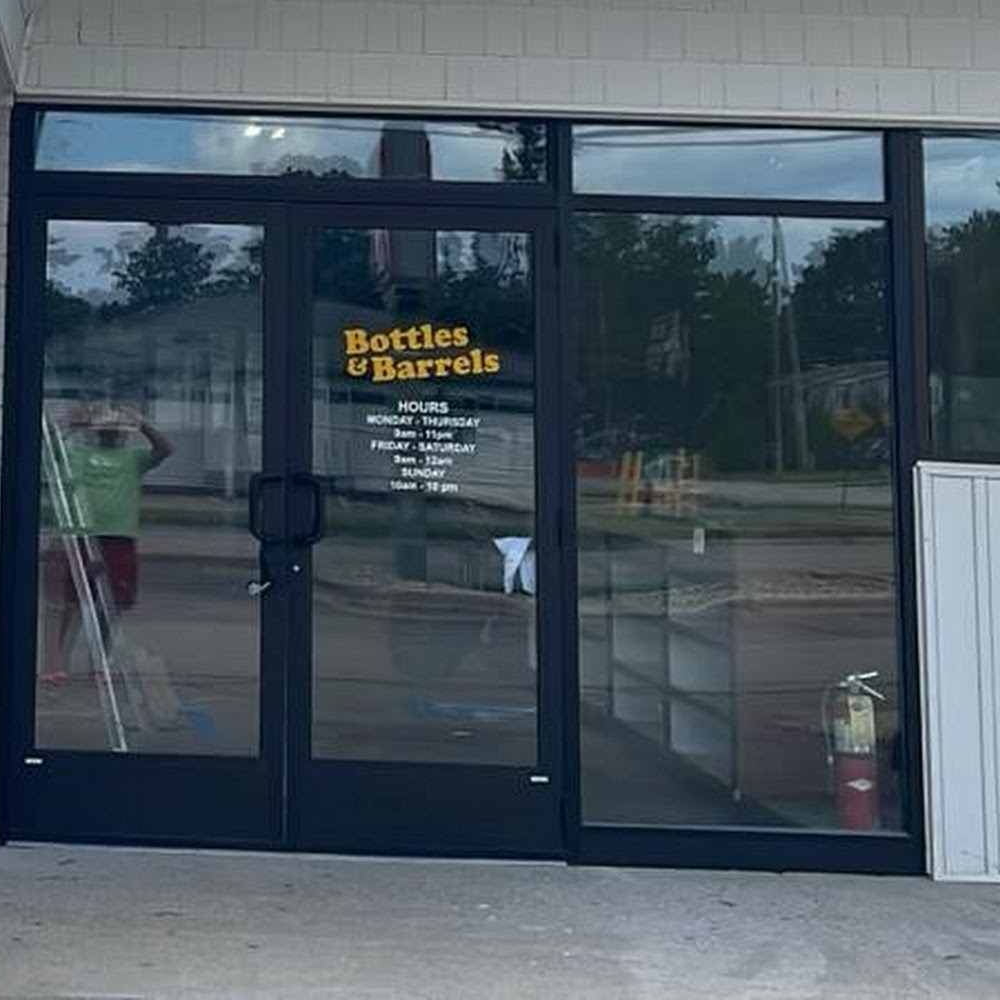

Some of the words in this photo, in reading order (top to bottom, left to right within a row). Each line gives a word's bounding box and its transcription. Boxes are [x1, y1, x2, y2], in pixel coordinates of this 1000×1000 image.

[343, 324, 470, 355] Bottles
[397, 401, 450, 414] HOURS
[366, 414, 414, 426] MONDAY
[422, 416, 481, 428] THURSDAY
[370, 440, 410, 451] FRIDAY
[418, 441, 477, 454] SATURDAY
[401, 467, 446, 479] SUNDAY
